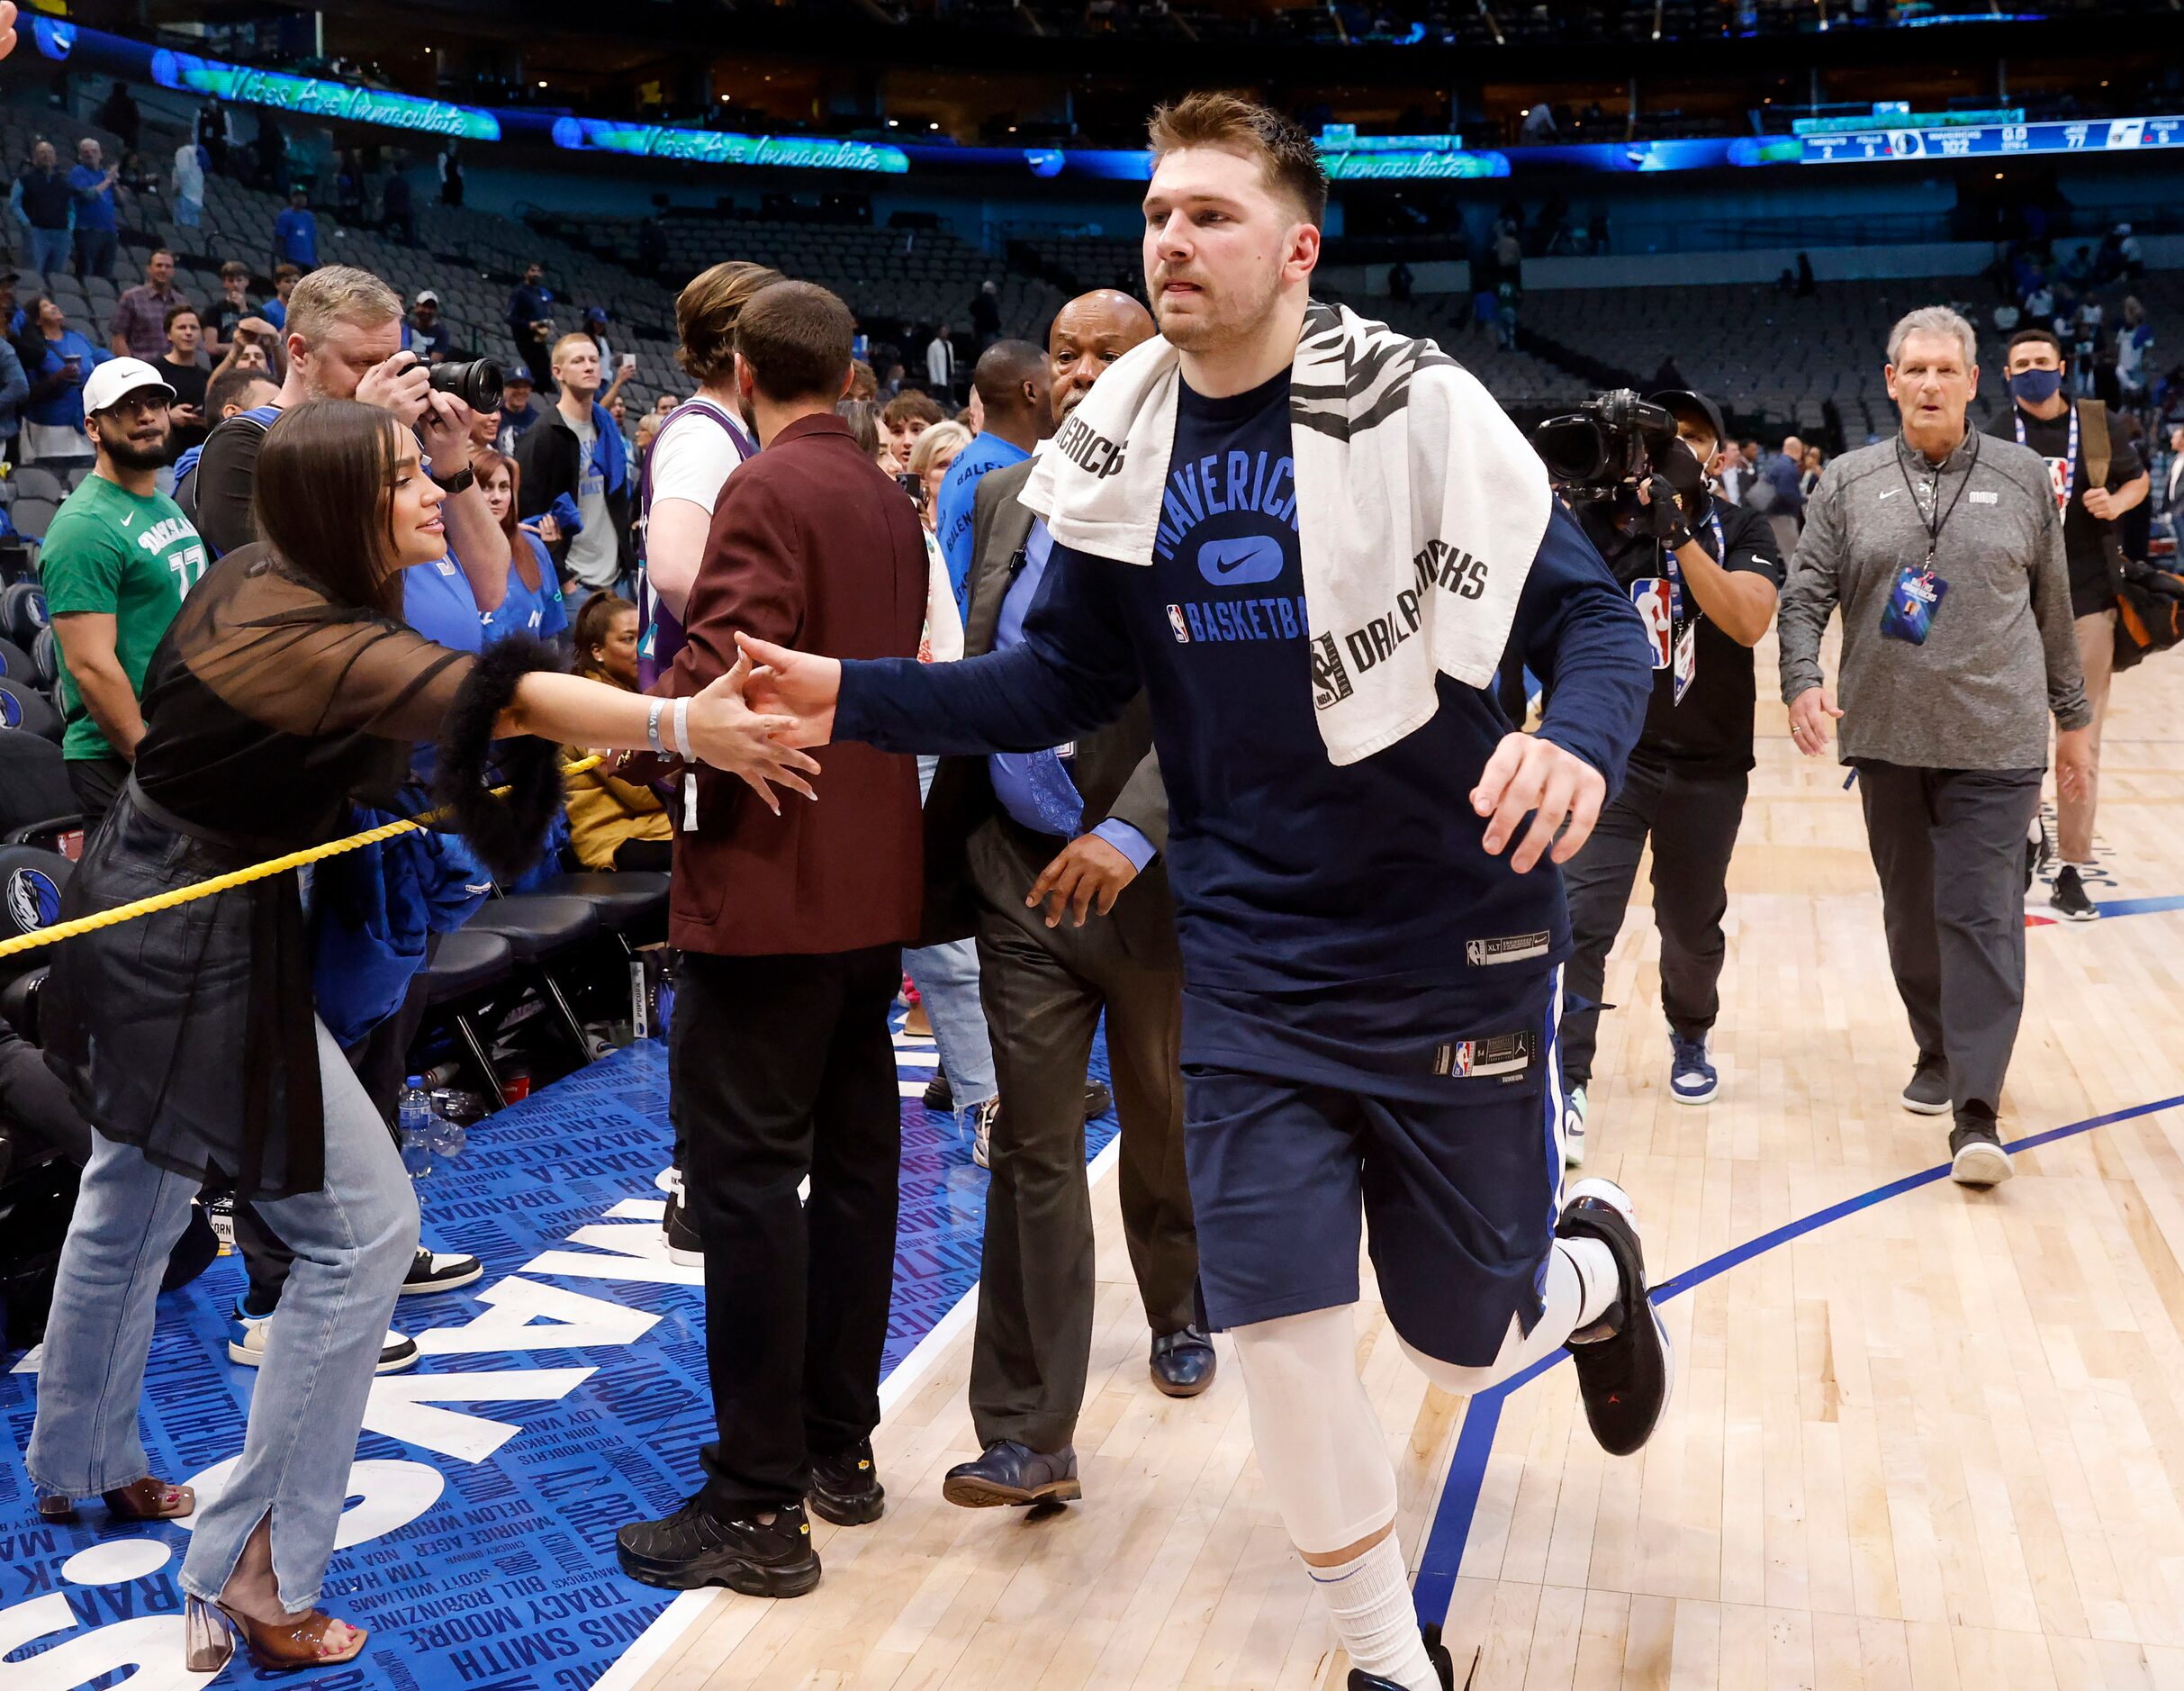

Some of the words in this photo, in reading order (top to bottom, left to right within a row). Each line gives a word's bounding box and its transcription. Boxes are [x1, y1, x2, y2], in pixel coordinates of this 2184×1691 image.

[1185, 596, 1309, 642] BASKETB
[1487, 944, 1501, 952] XLT
[465, 1126, 556, 1147] ROOKS
[559, 1113, 631, 1135] SEAN
[571, 1128, 662, 1153] MAXI
[448, 1142, 571, 1171] KLEBER
[521, 1150, 657, 1184] BAREA
[589, 1361, 709, 1430] JASON
[502, 1432, 557, 1456] JENKINS
[558, 1424, 600, 1442] JOHN
[586, 1433, 624, 1453] FRED
[517, 1442, 585, 1466] ROBERTS
[457, 1497, 536, 1528] DELON
[469, 1514, 557, 1547] MAURICE
[538, 1531, 579, 1556] KEVIN
[360, 1548, 402, 1568] NBA
[414, 1535, 465, 1560] AGER
[385, 1560, 432, 1586] TIM
[553, 1551, 594, 1575] OLLIE
[444, 1568, 492, 1594] SCOTT
[493, 1575, 547, 1601] BILL
[552, 1565, 621, 1591] MAVERICKS
[347, 1580, 438, 1614] WILLIAMS
[531, 1581, 632, 1626] TRACY
[363, 1591, 496, 1635] ROBINZINE
[399, 1605, 523, 1655] MOORE
[447, 1627, 582, 1683] SMITH
